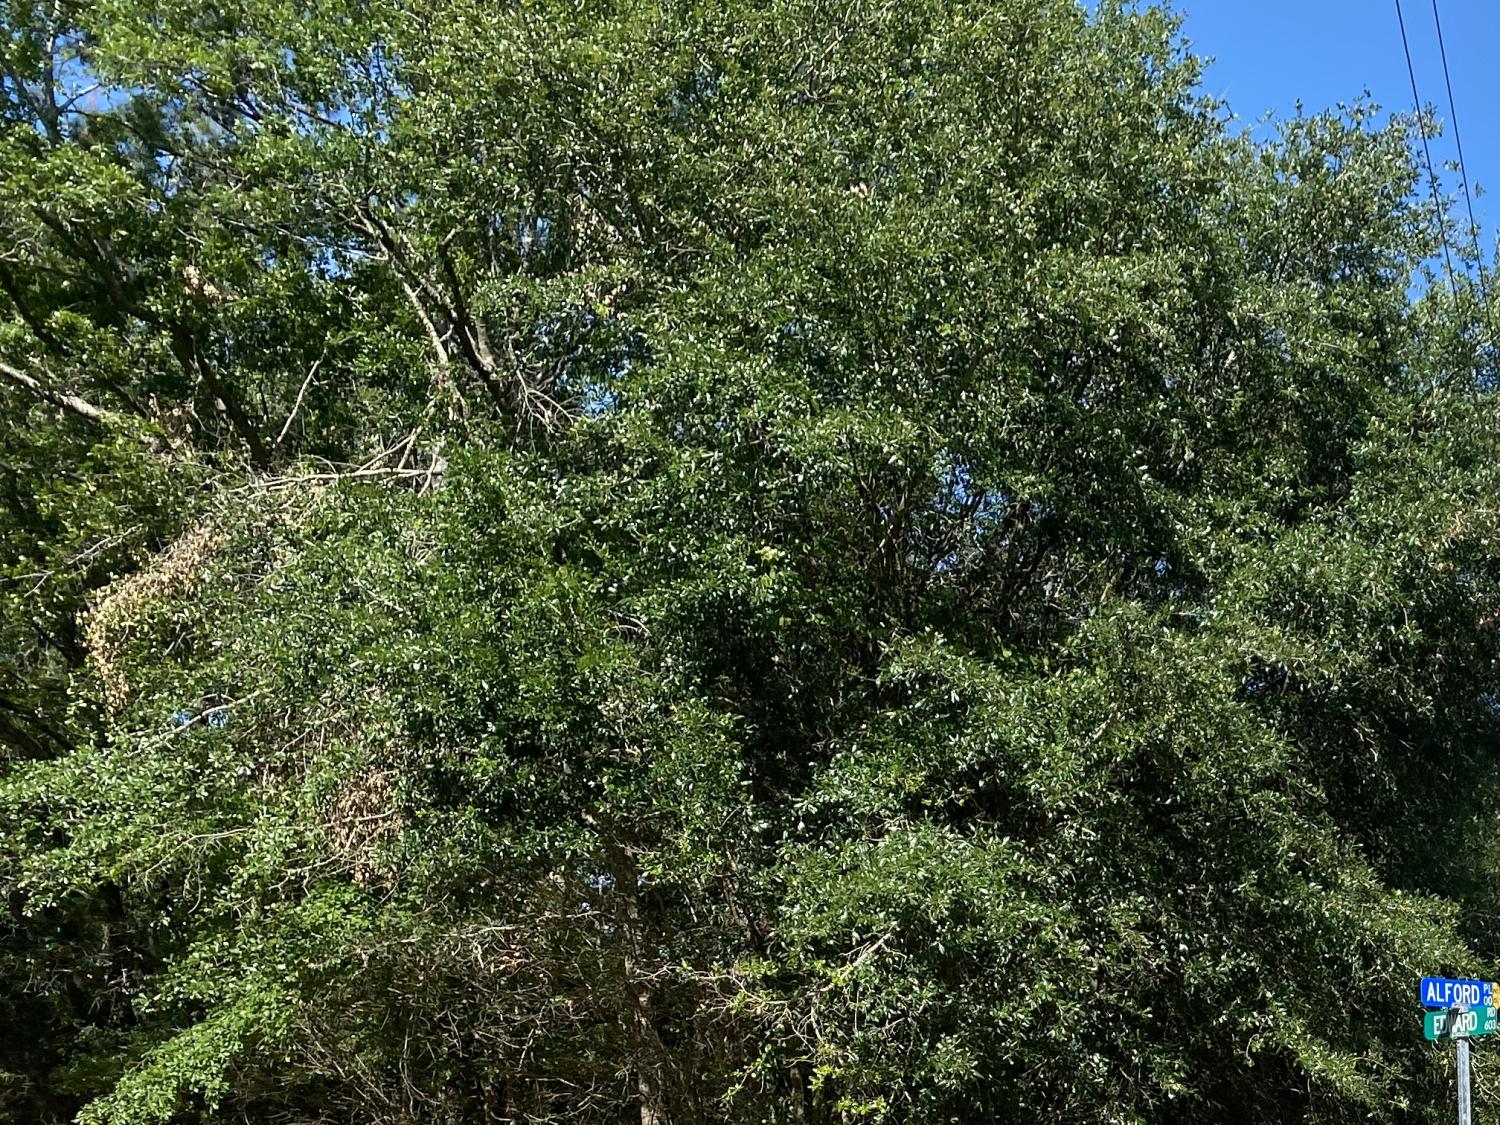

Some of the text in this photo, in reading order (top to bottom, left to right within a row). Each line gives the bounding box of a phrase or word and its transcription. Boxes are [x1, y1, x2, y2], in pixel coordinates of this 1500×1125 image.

[1427, 982, 1480, 1004] ALFORD
[1483, 984, 1493, 994] PL
[1433, 1007, 1496, 1035] EDWARD RD
[1484, 1020, 1496, 1031] 603
